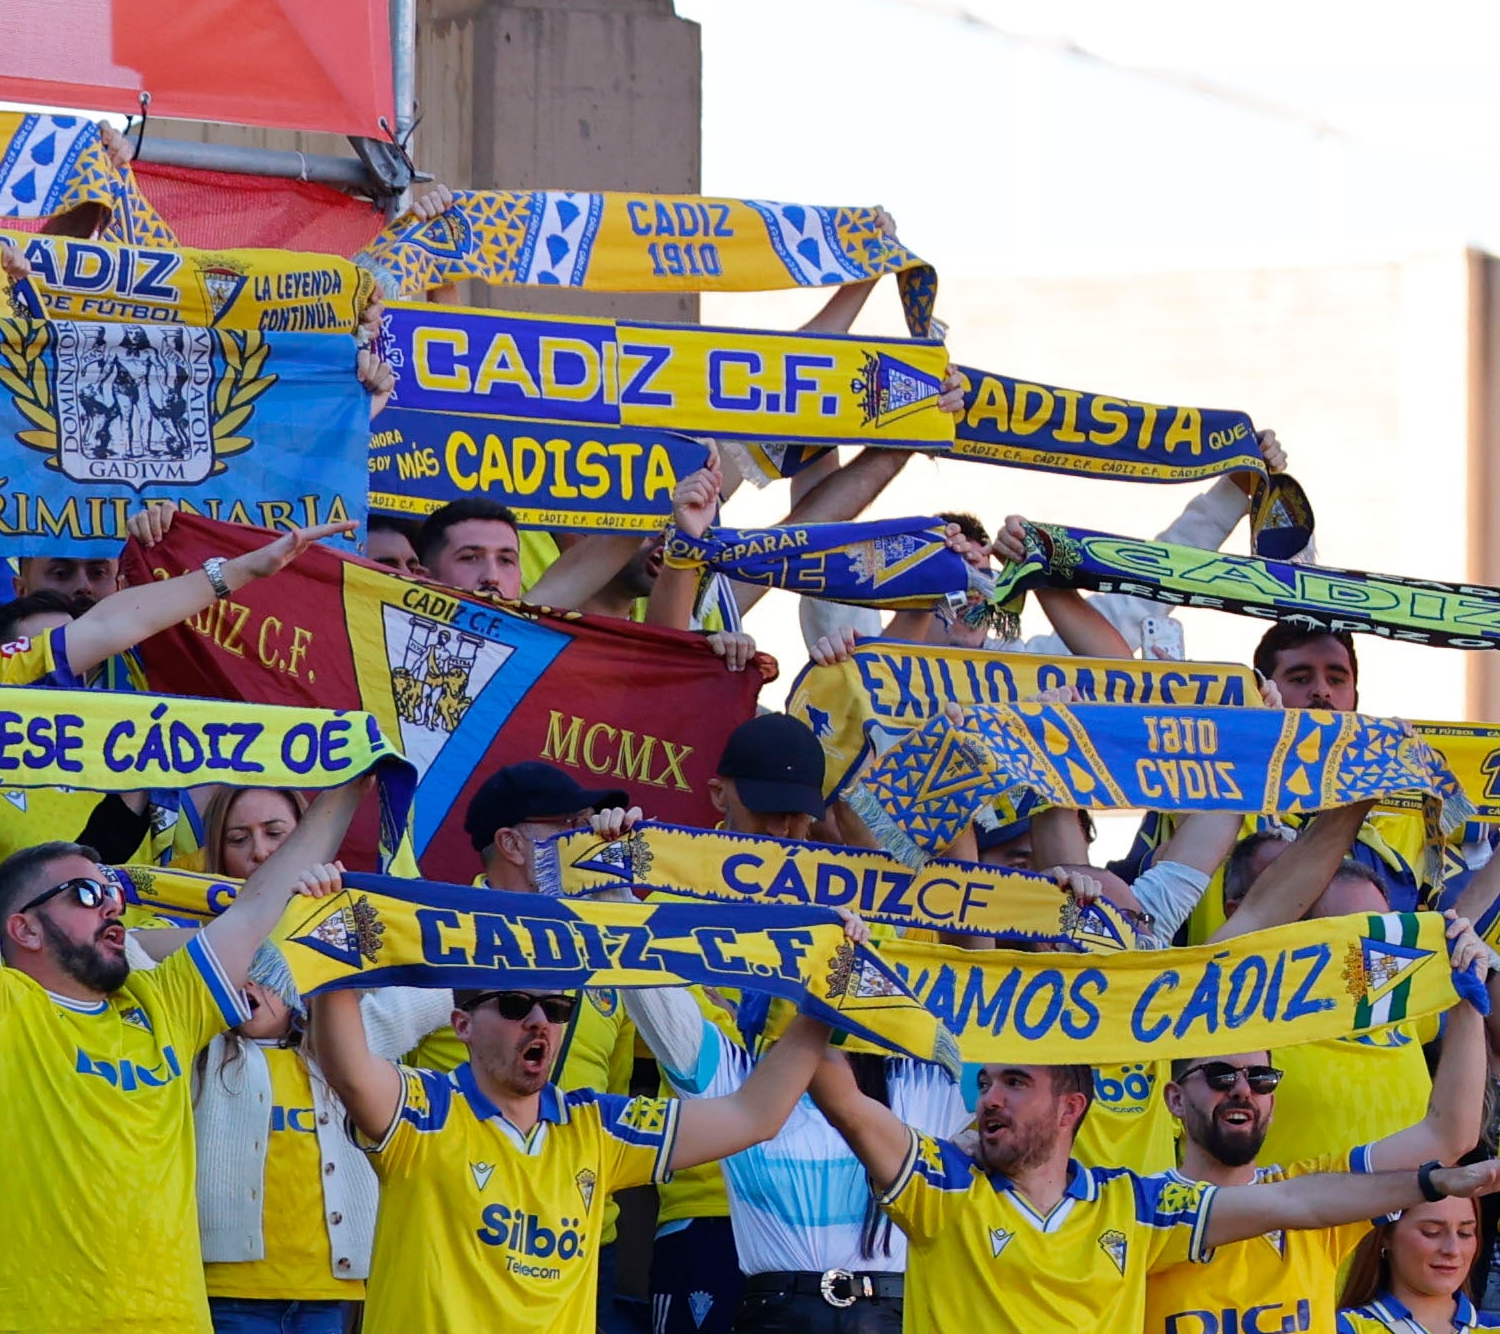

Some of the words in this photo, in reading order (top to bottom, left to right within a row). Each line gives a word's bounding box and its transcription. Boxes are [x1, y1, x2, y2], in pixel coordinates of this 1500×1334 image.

[628, 199, 735, 238] CADIZ
[648, 241, 722, 277] 1910
[251, 276, 278, 300] LA
[281, 268, 344, 298] LEYENDA
[39, 293, 78, 313] DE
[80, 297, 186, 324] FÚTBOL
[257, 304, 353, 332] CONTINÚA...
[413, 325, 677, 408] CADIZ
[706, 348, 842, 418] C.F.
[1209, 423, 1247, 451] QUE
[89, 461, 186, 482] GADIVM
[396, 452, 441, 480] MÁS
[444, 430, 678, 502] CADISTA
[402, 587, 465, 624] CADIZ
[255, 617, 318, 682] C.F.
[103, 704, 264, 774] CÁDIZ
[539, 710, 694, 793] MCMX
[416, 910, 650, 970] CADIZ
[1131, 942, 1336, 1043] CÁDIZ
[504, 1255, 562, 1281] Telecom
